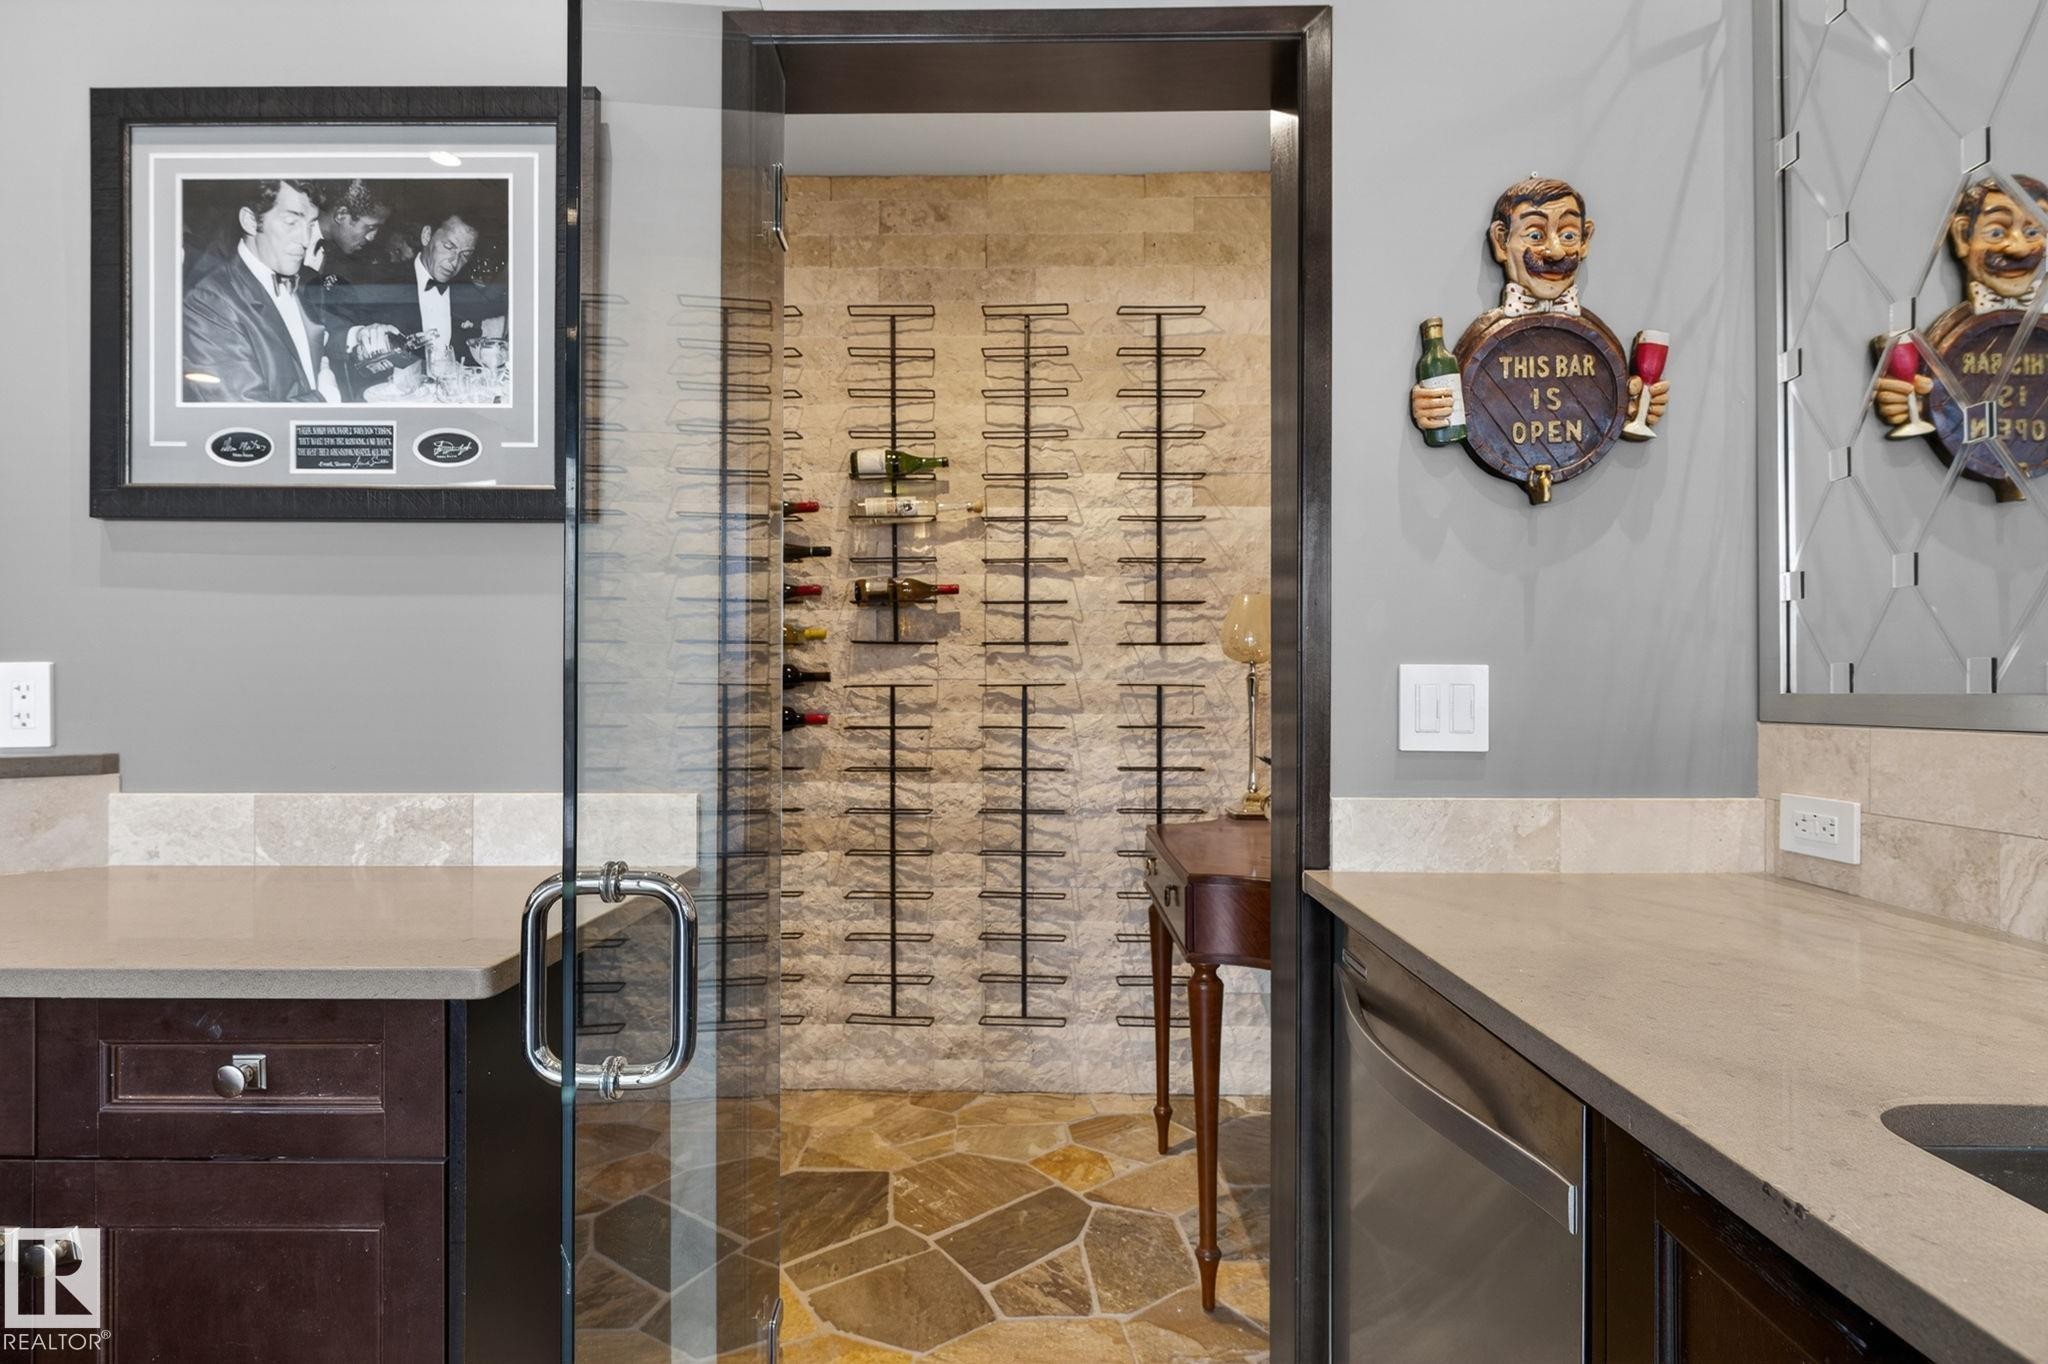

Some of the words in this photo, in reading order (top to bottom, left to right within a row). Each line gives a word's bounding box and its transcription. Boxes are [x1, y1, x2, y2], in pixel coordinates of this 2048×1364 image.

[1499, 355, 1550, 379] THIS
[1555, 354, 1596, 378] BAR
[1530, 387, 1562, 411] IS
[1512, 419, 1582, 444] OPEN
